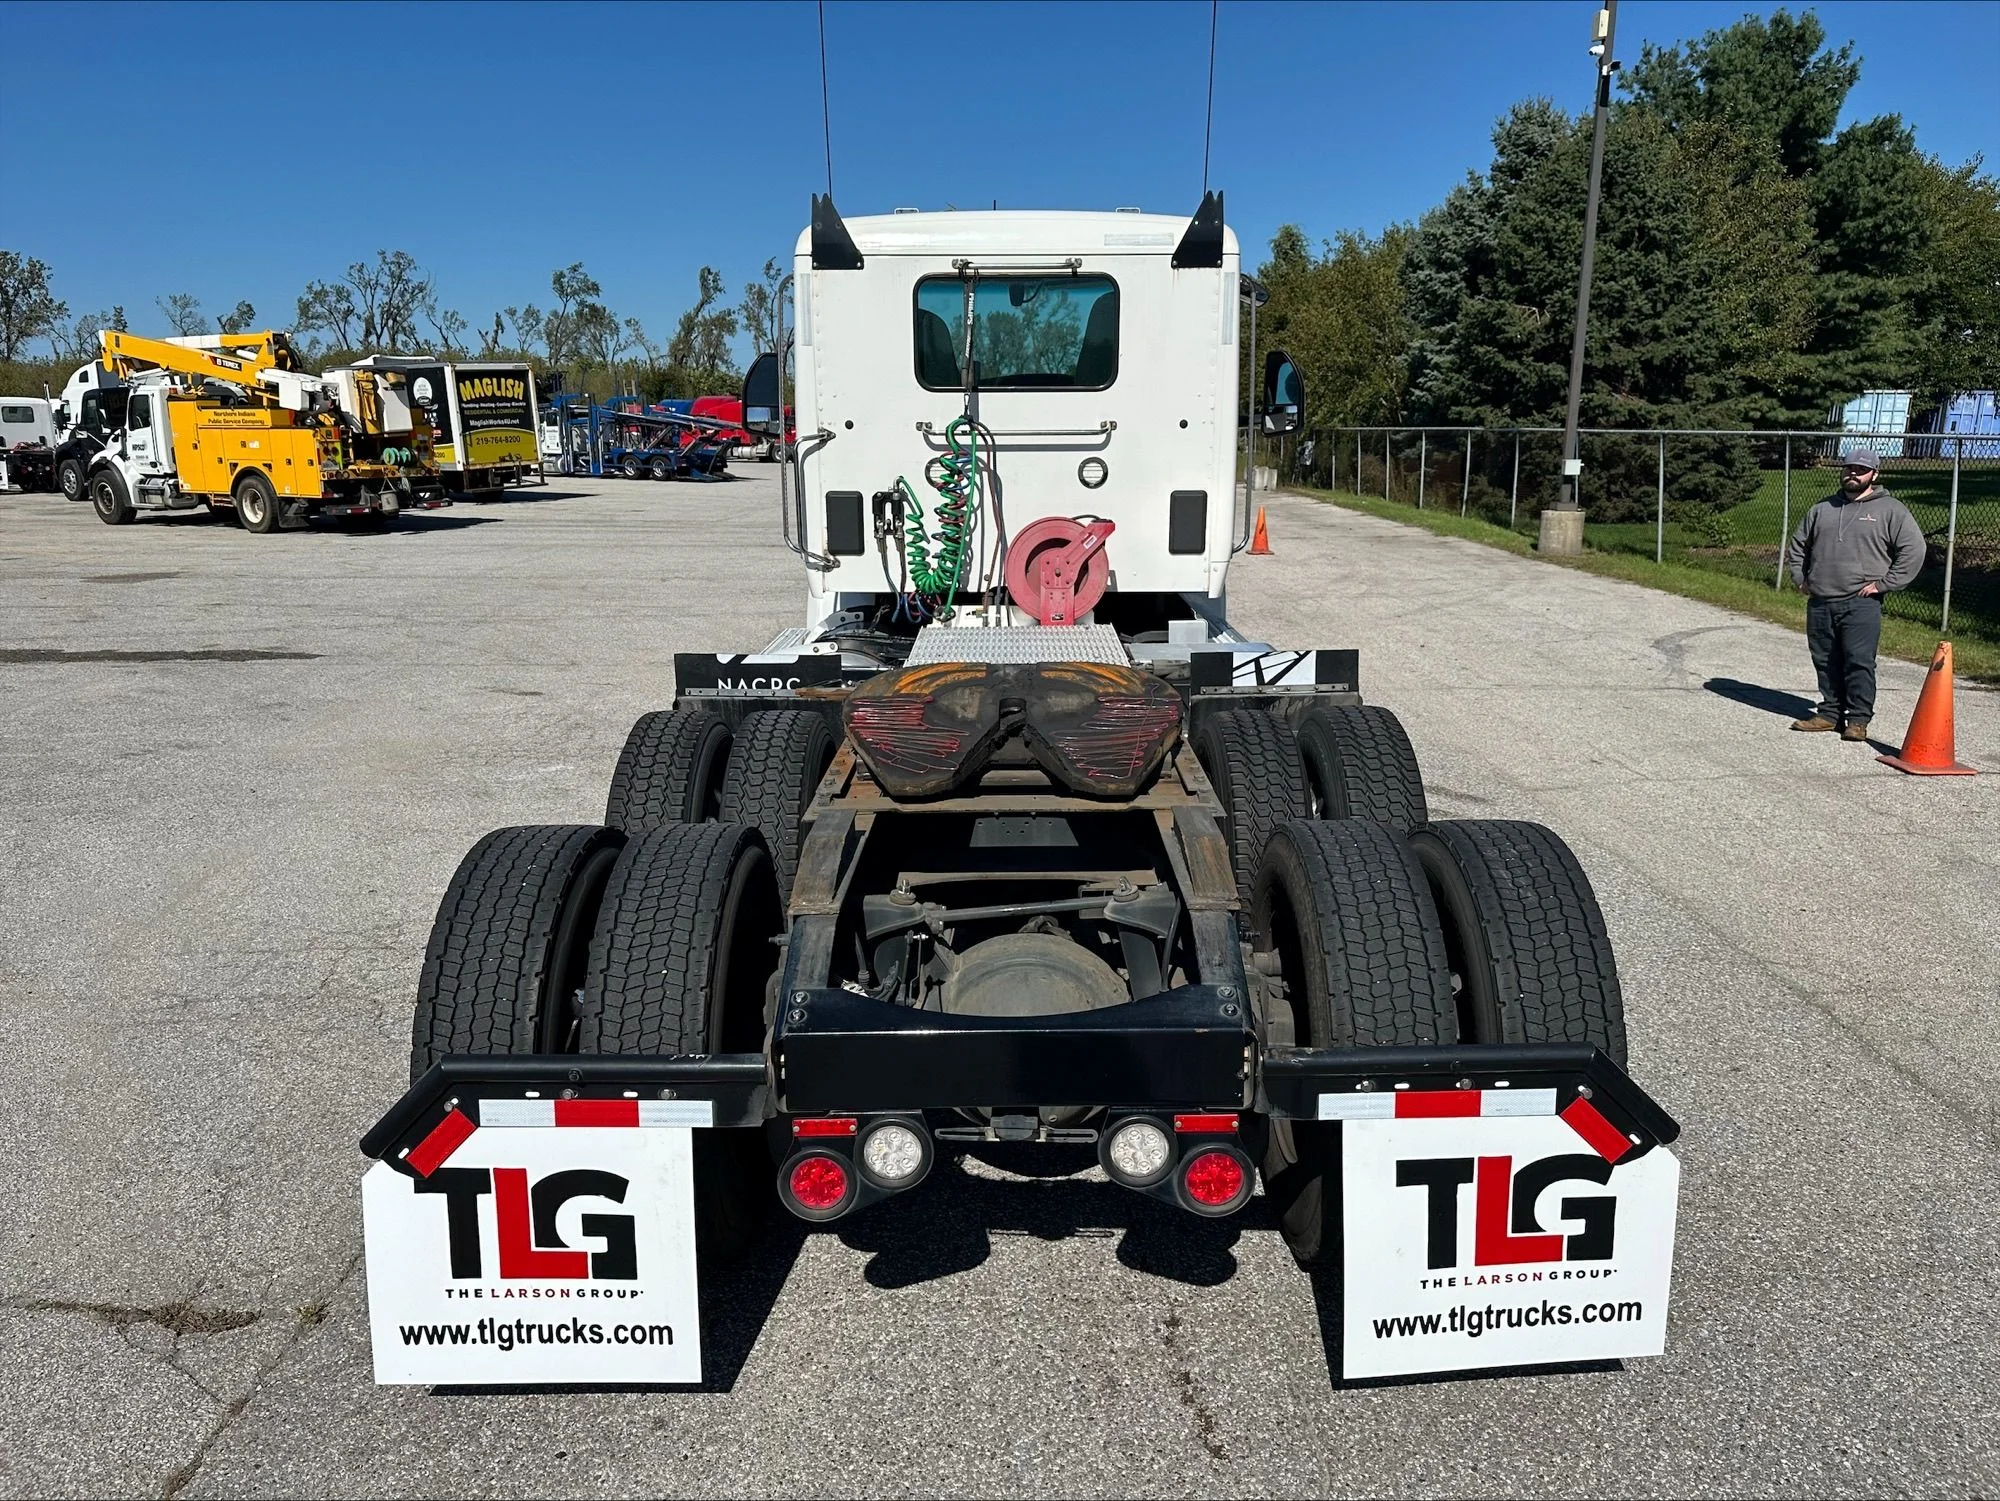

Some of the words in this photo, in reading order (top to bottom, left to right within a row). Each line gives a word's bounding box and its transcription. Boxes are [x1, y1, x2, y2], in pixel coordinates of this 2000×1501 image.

[967, 292, 975, 325] PHILIPS
[459, 377, 525, 402] MAGLISH
[476, 435, 521, 445] 219-764-8200
[414, 1167, 638, 1280] TLG
[1395, 1153, 1618, 1270] TLG
[445, 1288, 484, 1299] THE
[490, 1288, 571, 1299] LARSON
[1419, 1277, 1458, 1290] THE
[1463, 1271, 1543, 1287] LARSON
[399, 1317, 674, 1351] www.tlgtrucks.com
[1372, 1300, 1643, 1339] www.tlgtrucks.com
